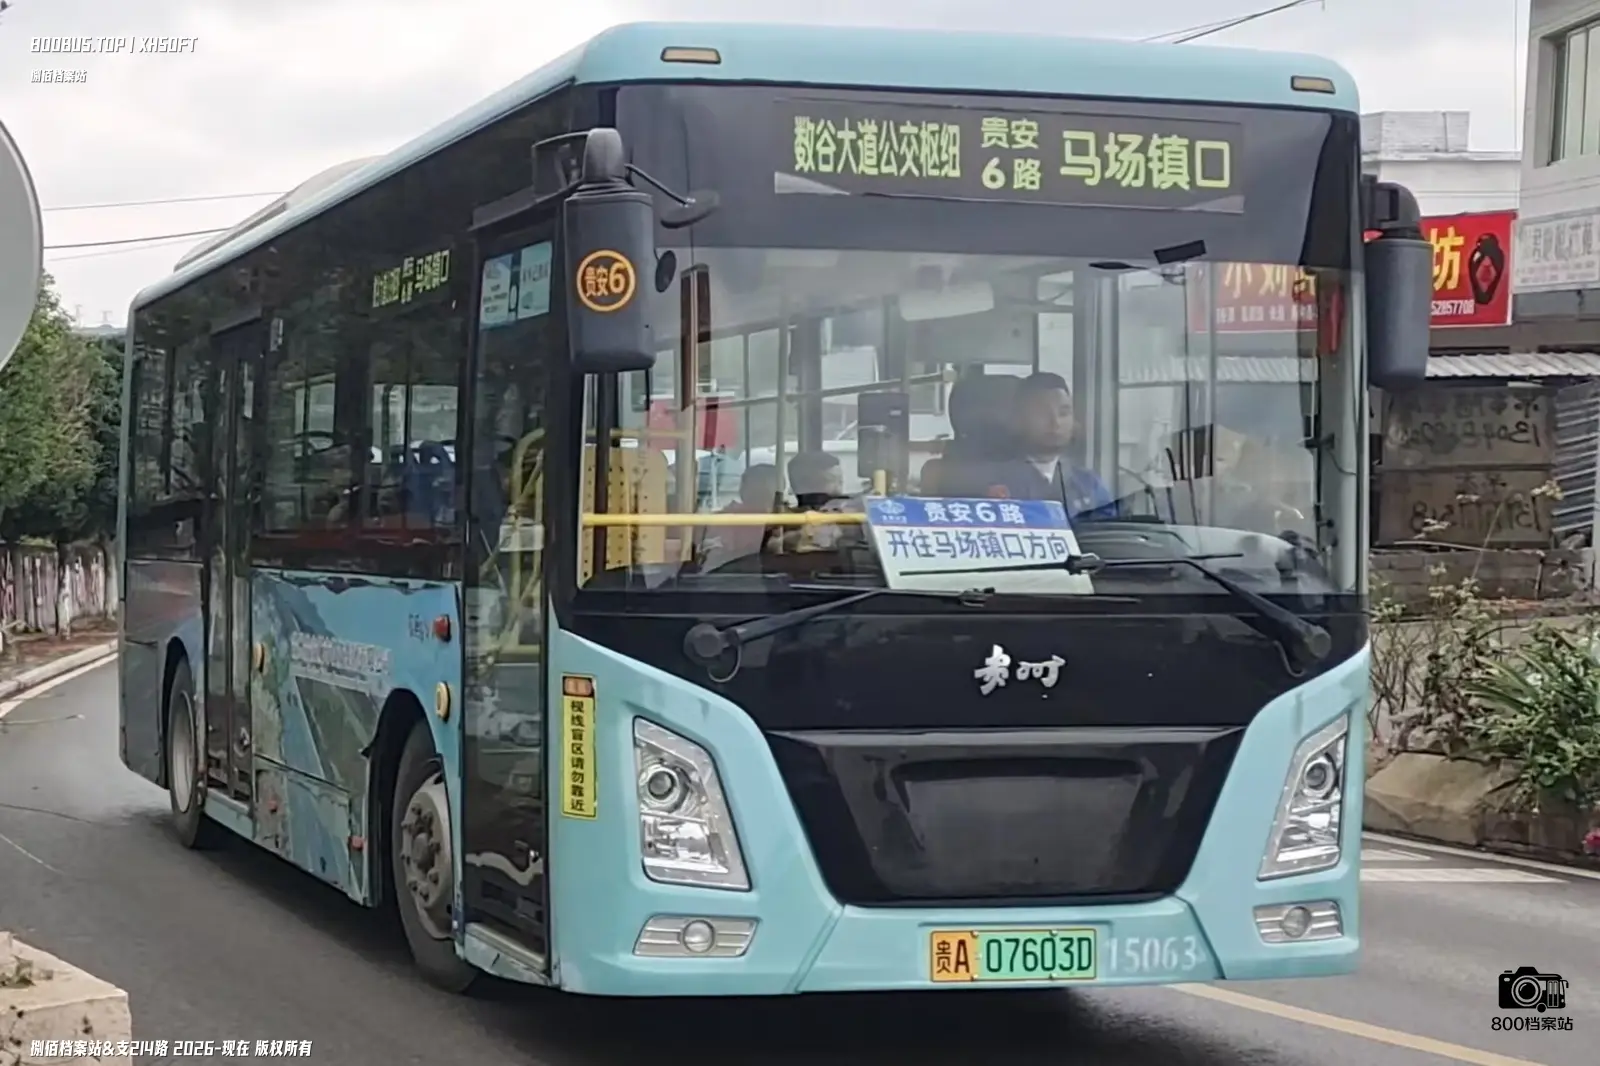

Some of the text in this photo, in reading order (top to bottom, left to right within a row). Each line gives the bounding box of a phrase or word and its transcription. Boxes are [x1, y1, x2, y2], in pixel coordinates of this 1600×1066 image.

[794, 116, 961, 178] 数谷大道公交枢纽
[981, 117, 1039, 150] 贵安
[1059, 130, 1230, 191] 马场镇口
[585, 262, 627, 298] 贵安6
[924, 502, 1025, 524] 贵安6路
[570, 700, 585, 812] 视线盲区请勿靠近
[1107, 935, 1197, 973] 15063
